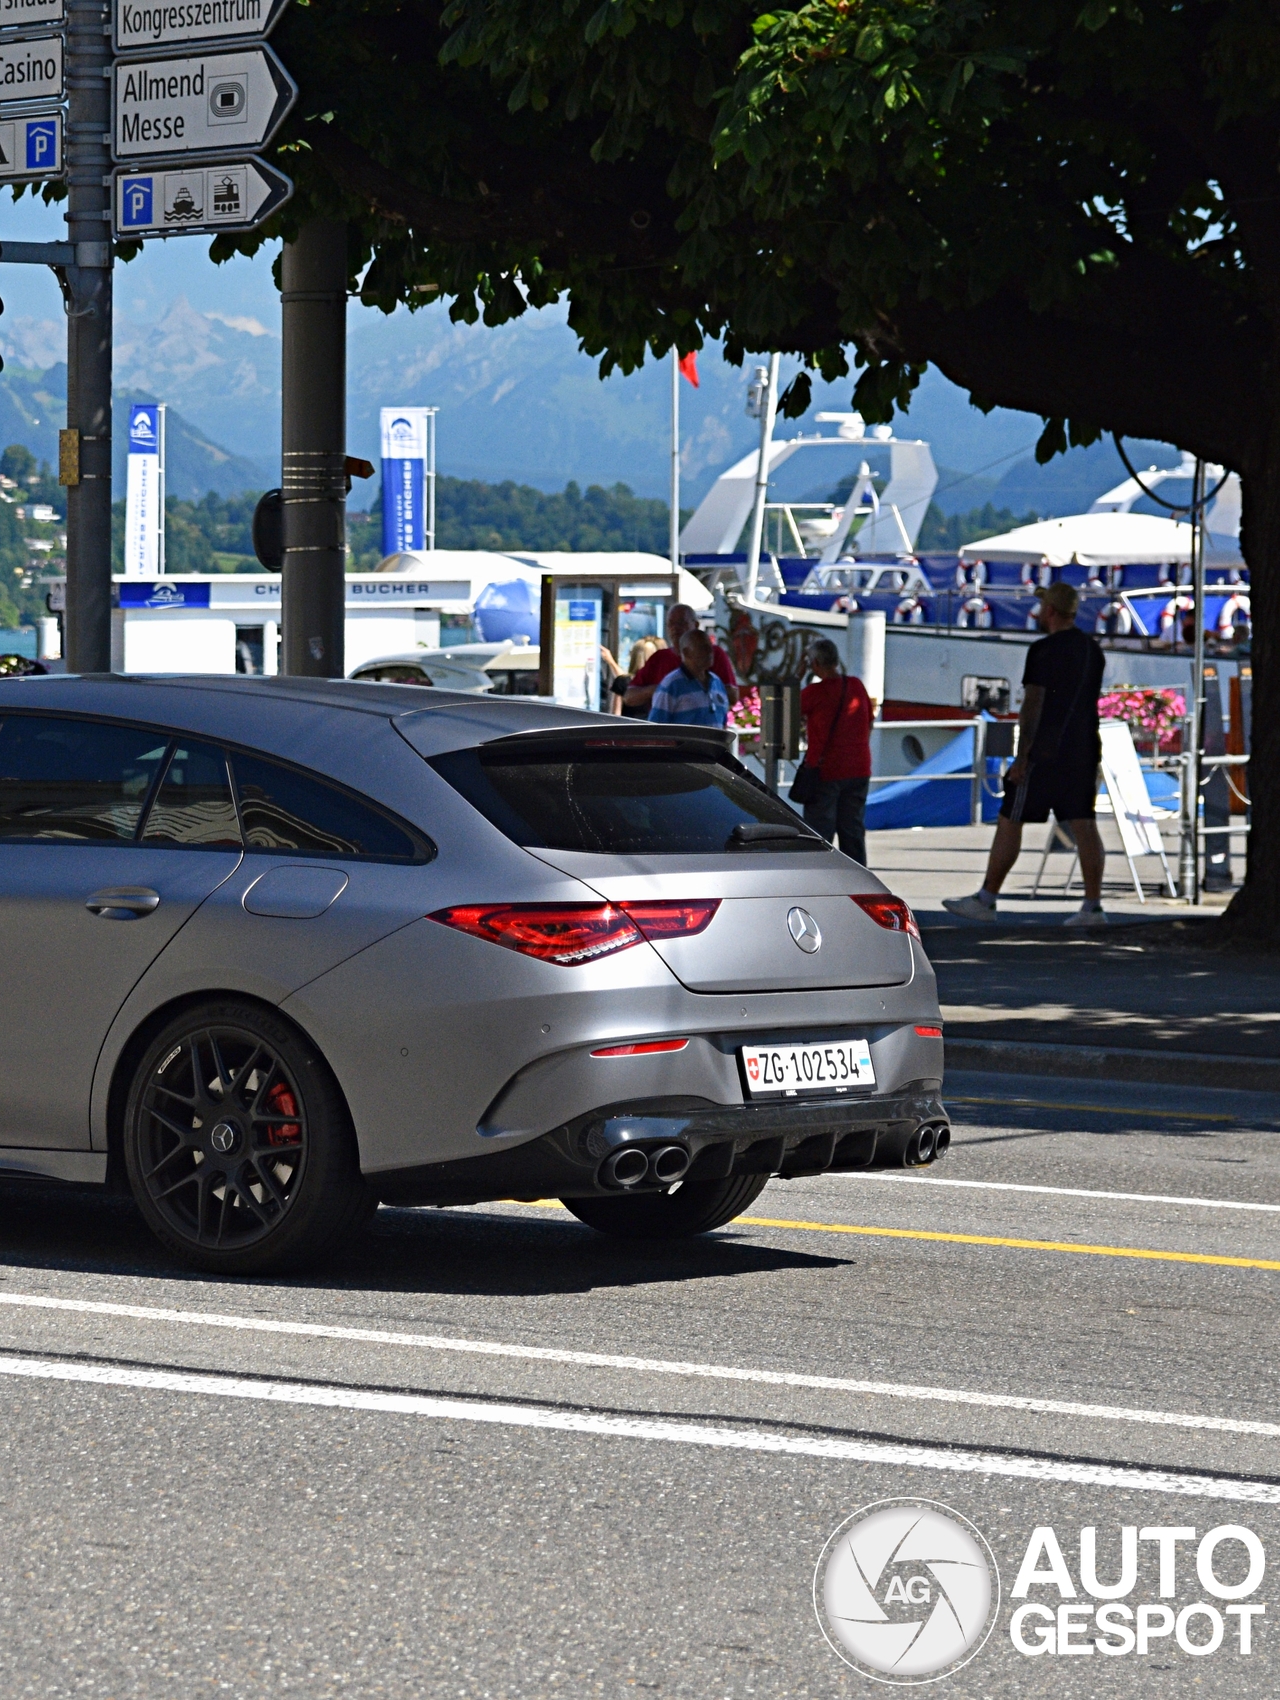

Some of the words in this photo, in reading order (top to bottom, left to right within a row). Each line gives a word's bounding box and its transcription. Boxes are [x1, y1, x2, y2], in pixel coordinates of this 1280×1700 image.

[123, 0, 261, 39] Kongresszentrum
[123, 64, 205, 103] Allmend
[122, 113, 185, 143] Messe
[352, 584, 430, 595] BUCHER
